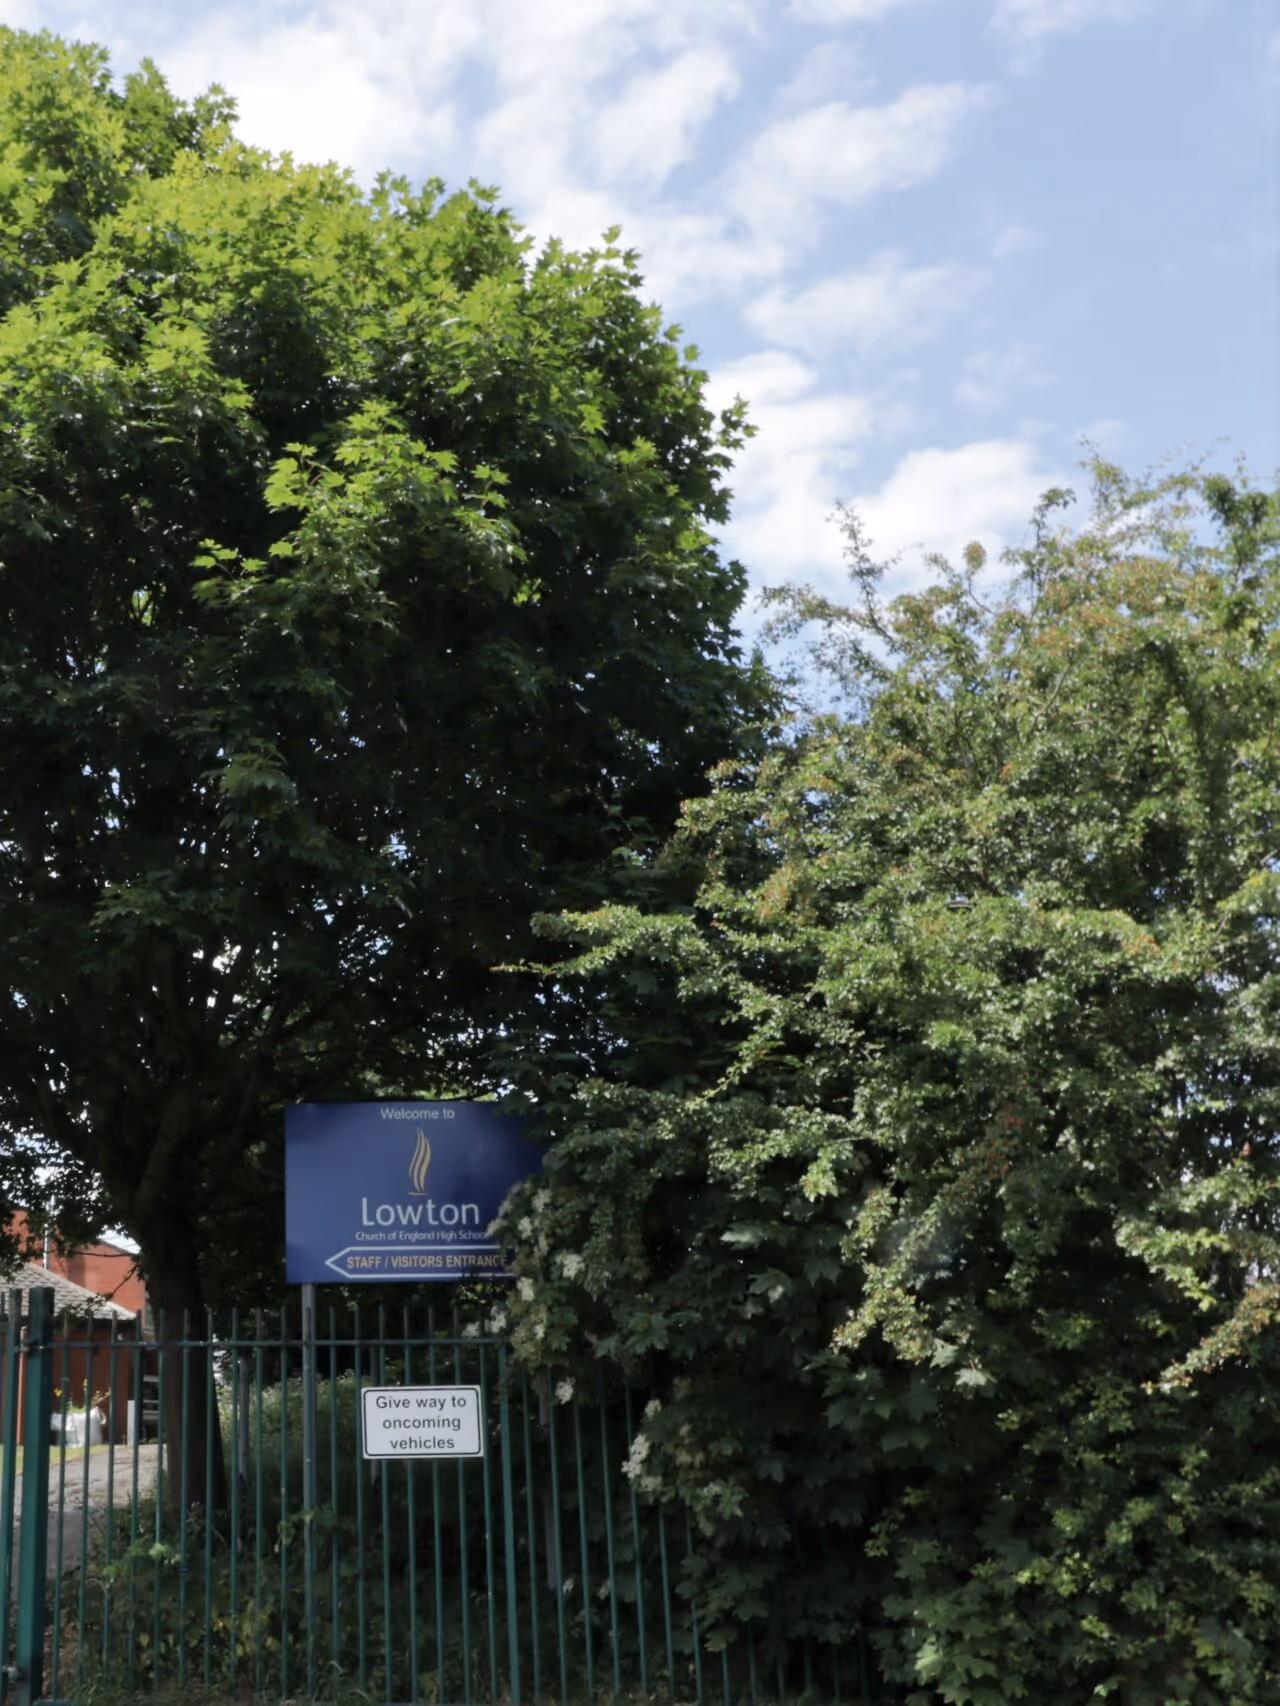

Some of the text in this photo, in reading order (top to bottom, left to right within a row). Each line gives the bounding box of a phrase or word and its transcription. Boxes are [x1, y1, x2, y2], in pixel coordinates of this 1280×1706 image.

[380, 1107, 455, 1120] Welcome to
[362, 1197, 480, 1226] Lowton
[355, 1229, 490, 1242] Church of England High Schoo
[346, 1256, 381, 1269] STAFF
[390, 1256, 443, 1268] VISITORS
[376, 1395, 467, 1411] Give way to
[382, 1415, 461, 1431] oncoming
[390, 1436, 455, 1449] vehicles
